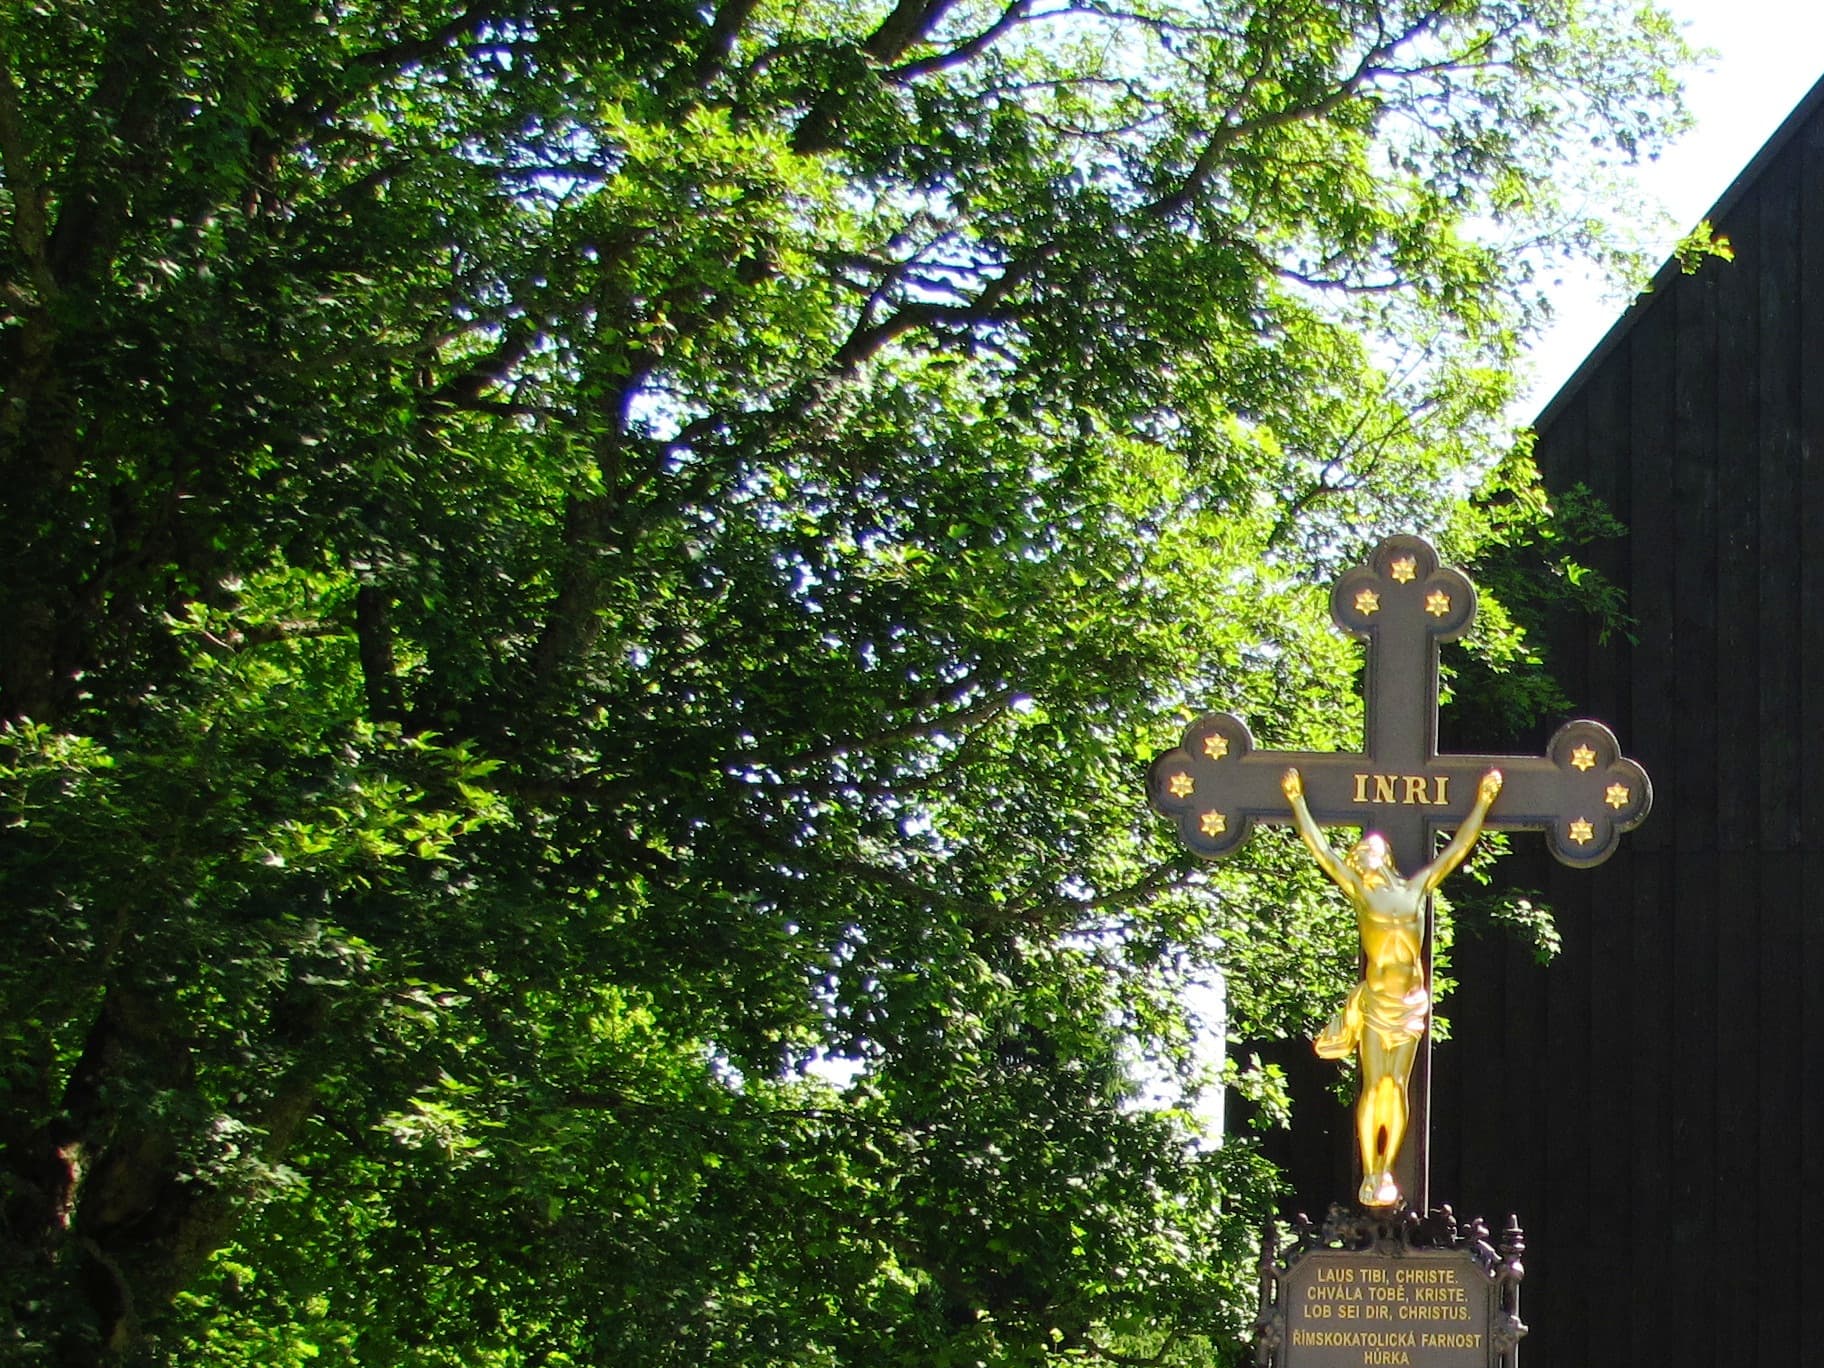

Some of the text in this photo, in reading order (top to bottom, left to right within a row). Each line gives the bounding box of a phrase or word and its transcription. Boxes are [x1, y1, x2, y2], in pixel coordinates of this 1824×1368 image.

[1353, 774, 1449, 805] INRI
[1317, 1268, 1459, 1286] LAUS TIBI, CHRISTE.
[1307, 1283, 1469, 1303] CHVÁLA TOBĚ, KRISTE.
[1303, 1304, 1472, 1321] LOB SEI DIR, CHRISTUS.
[1292, 1329, 1481, 1348] ŘÍMSKOKATOLICKÁ FARNOST
[1363, 1347, 1410, 1365] HŮRKA
